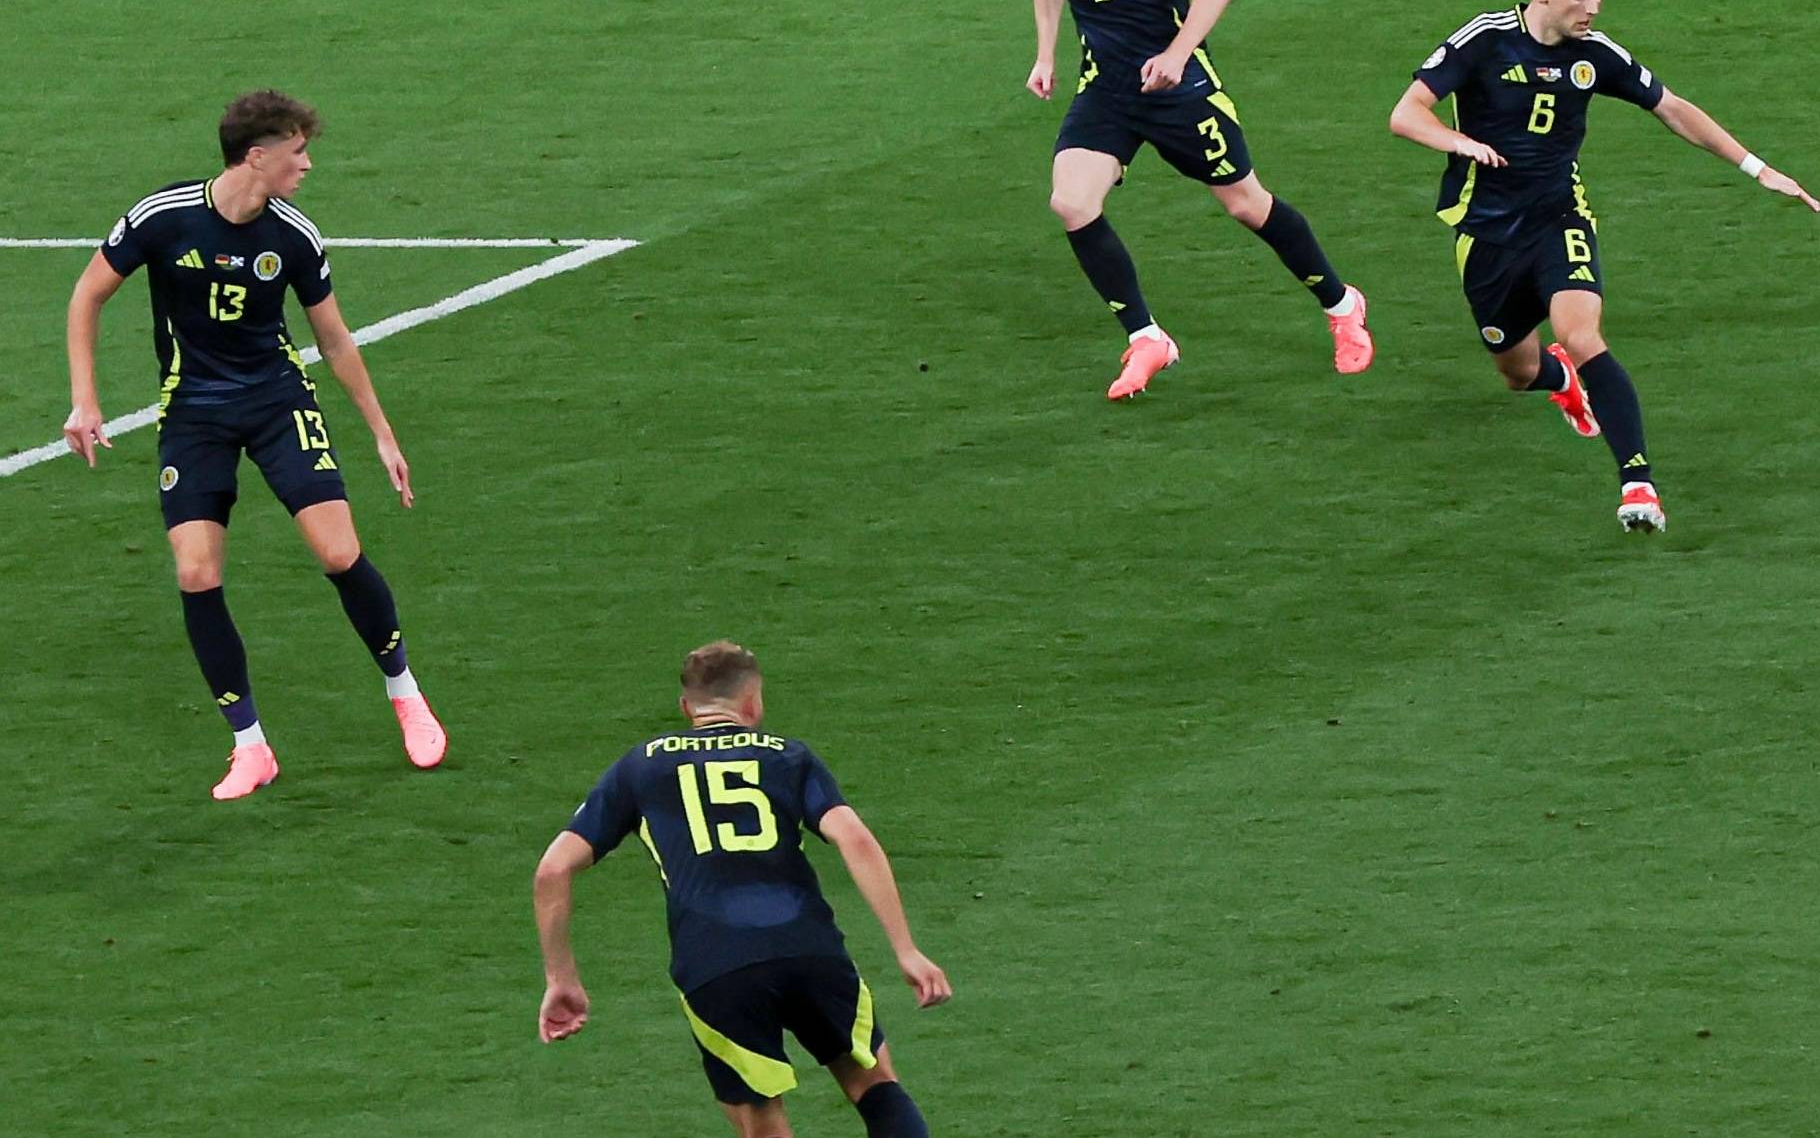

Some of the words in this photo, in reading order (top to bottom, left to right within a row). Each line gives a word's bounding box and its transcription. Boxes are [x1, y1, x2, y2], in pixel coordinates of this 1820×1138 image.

[1527, 93, 1555, 134] 6
[1197, 116, 1228, 162] 3
[1564, 228, 1592, 263] 6
[208, 282, 247, 321] 13
[293, 409, 331, 451] 13
[646, 732, 785, 758] PORTEOUS
[677, 760, 779, 856] 15
